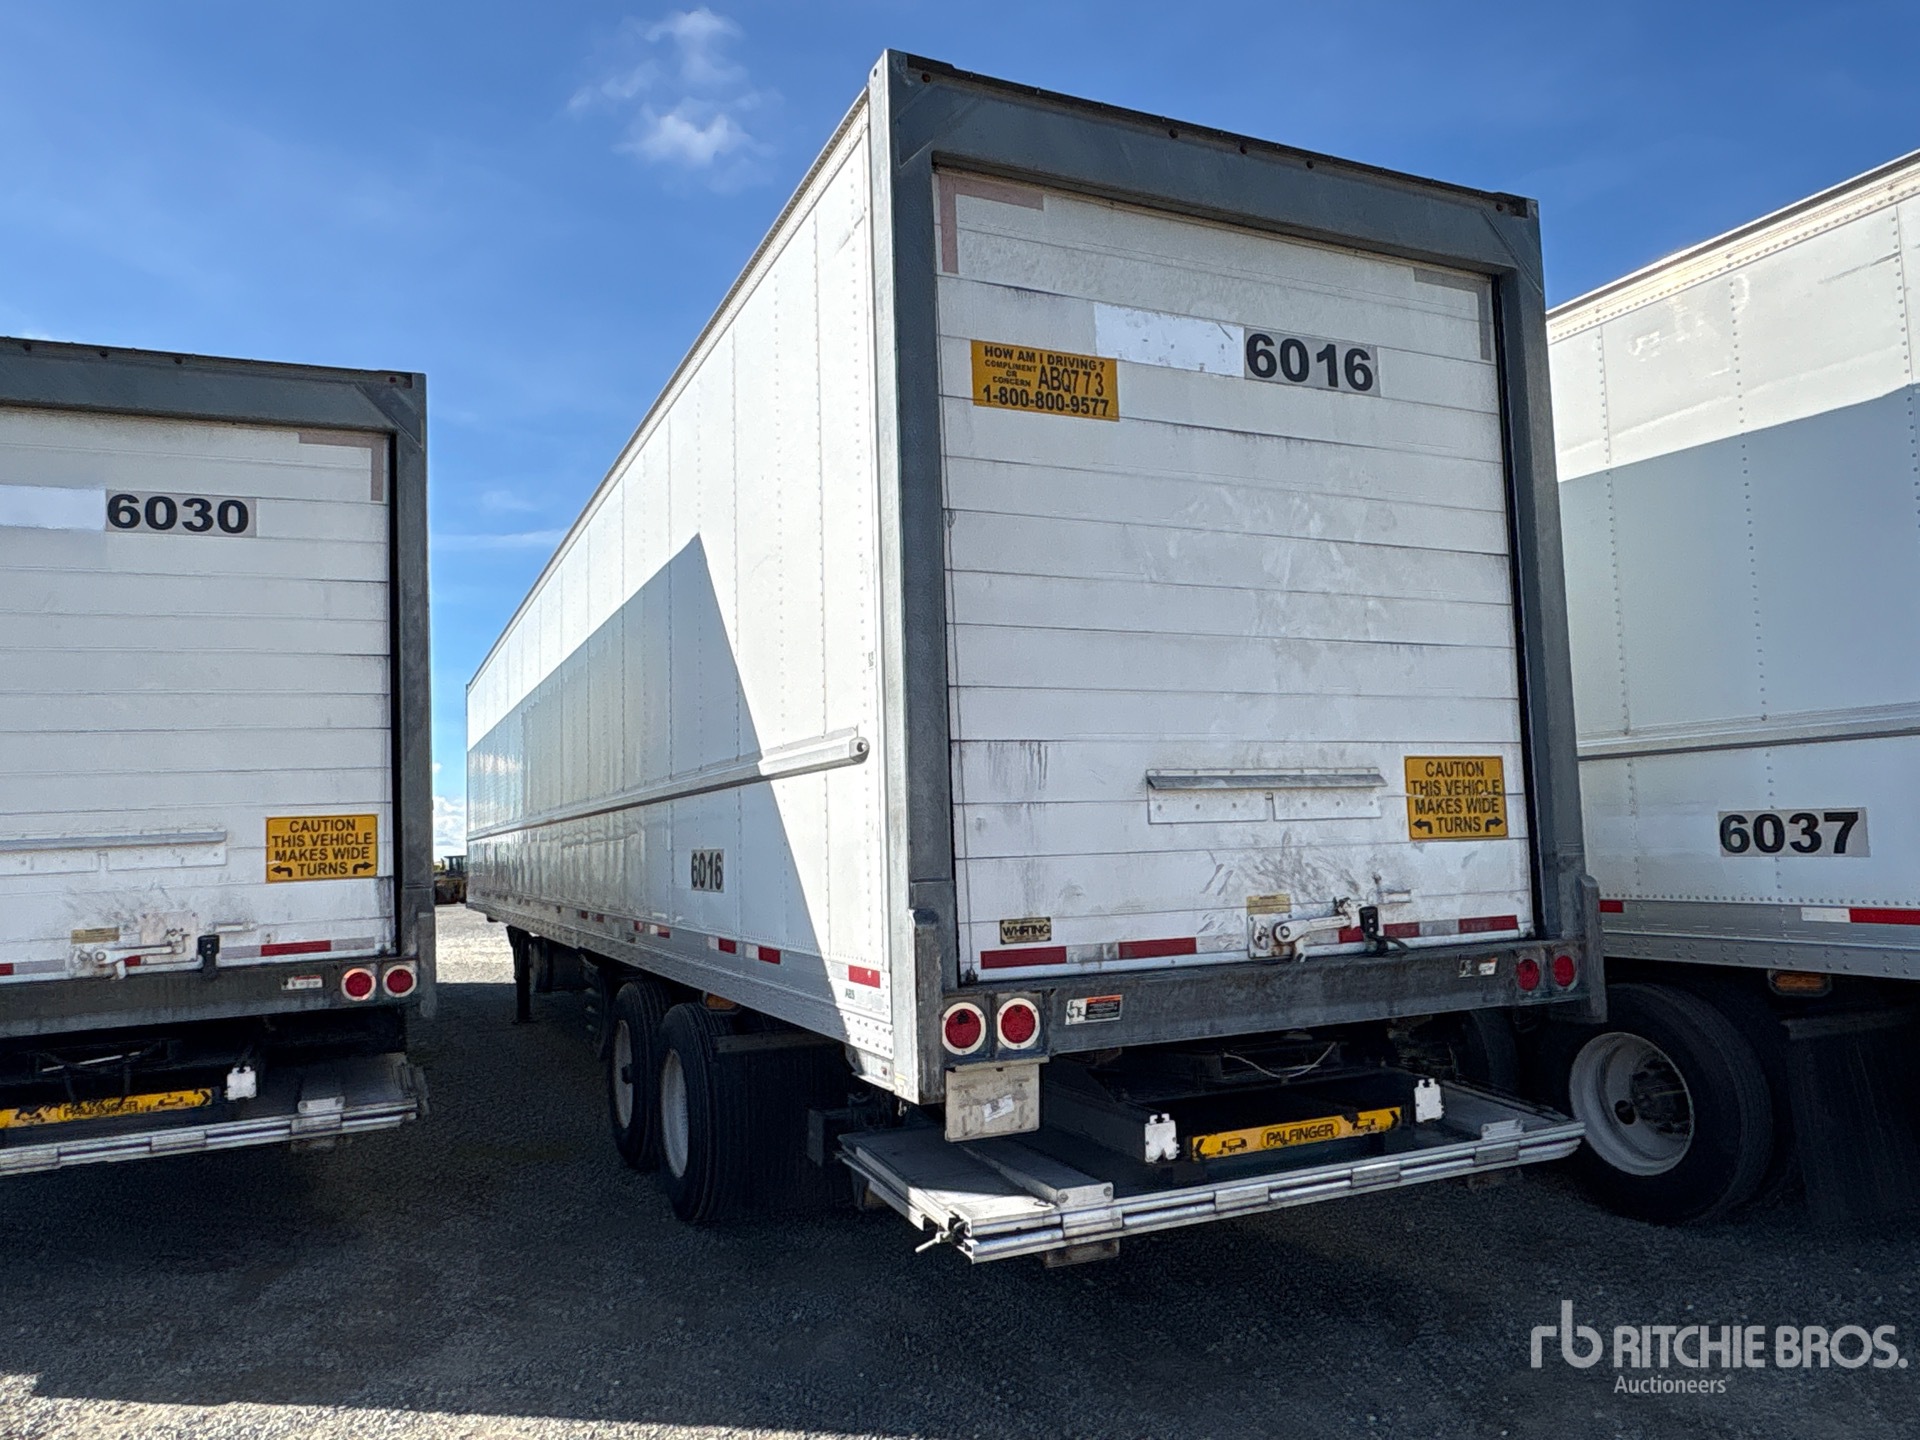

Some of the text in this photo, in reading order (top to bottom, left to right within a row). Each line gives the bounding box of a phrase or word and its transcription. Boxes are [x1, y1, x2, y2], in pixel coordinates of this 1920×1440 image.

[984, 345, 1014, 360] HOW
[1017, 351, 1036, 363] AM
[1039, 353, 1043, 364] I
[1047, 354, 1097, 371] DRIVING
[984, 359, 1037, 373] COMPLIMENT
[1246, 333, 1373, 391] 6016
[992, 375, 1031, 388] CONCERN
[1006, 370, 1017, 378] OR
[983, 384, 1110, 417] 1-800-800-9577
[107, 493, 249, 534] 6030
[1425, 761, 1485, 778] CAUTION
[1410, 779, 1501, 797] THIS VEHICLE
[1414, 797, 1500, 815] MAKES WIDE
[289, 818, 356, 833] CAUTION
[1436, 816, 1481, 833] TURNS
[1719, 811, 1859, 854] 6037
[272, 832, 373, 848] THIS VEHICLE
[274, 846, 370, 862] MAKES WIDE
[297, 862, 348, 877] TURNS
[691, 852, 723, 890] 6016
[1266, 1123, 1334, 1146] PALFINGER
